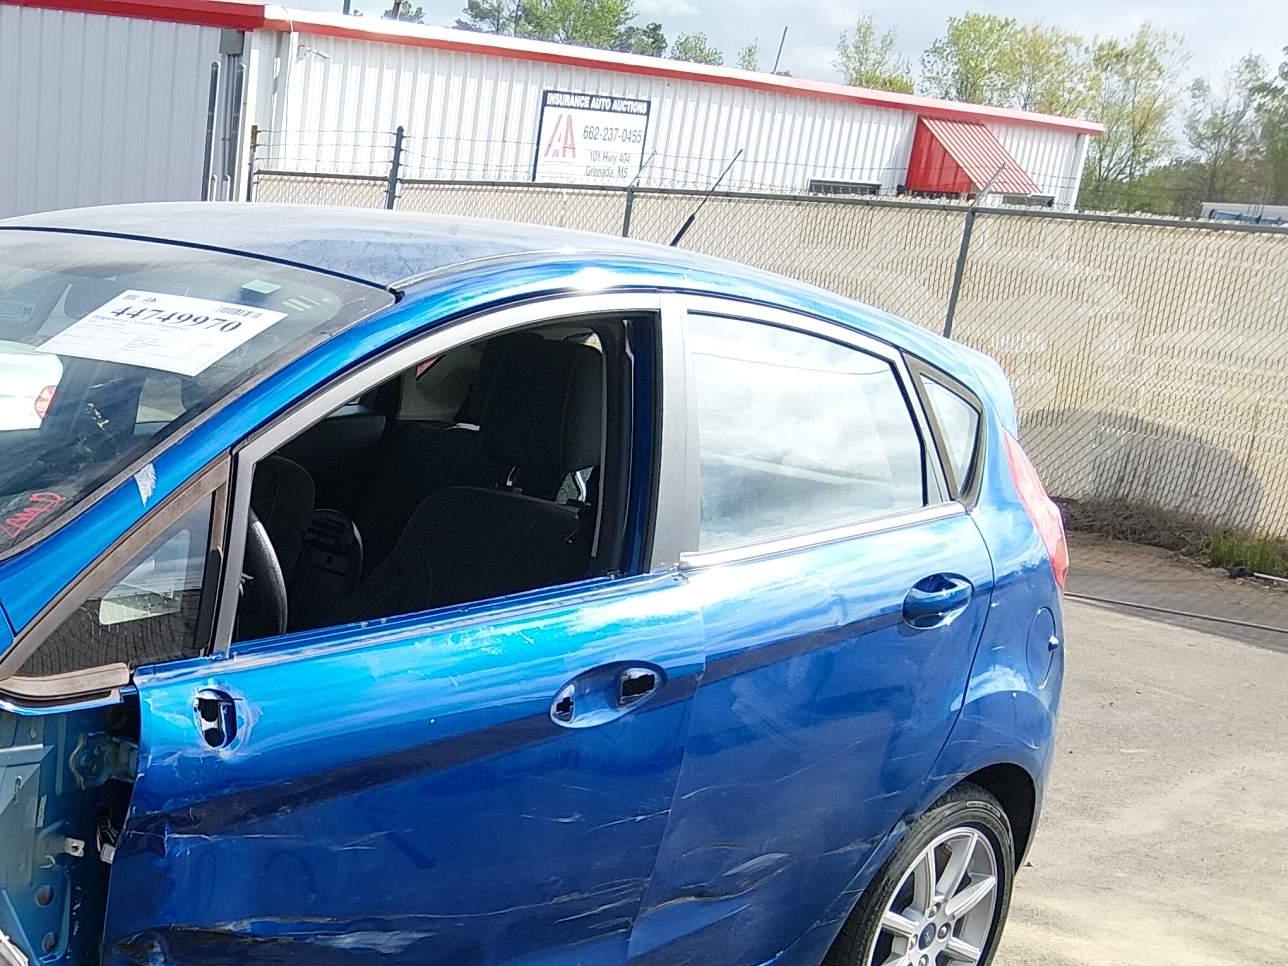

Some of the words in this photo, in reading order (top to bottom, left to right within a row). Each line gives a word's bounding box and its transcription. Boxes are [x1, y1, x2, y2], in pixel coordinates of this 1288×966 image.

[546, 92, 590, 108] INSURANCE
[591, 97, 612, 110] AUTO
[612, 99, 648, 114] AUCTIONS
[583, 125, 643, 143] 662-237-0455
[617, 165, 628, 178] MS
[110, 305, 242, 333] 44749970
